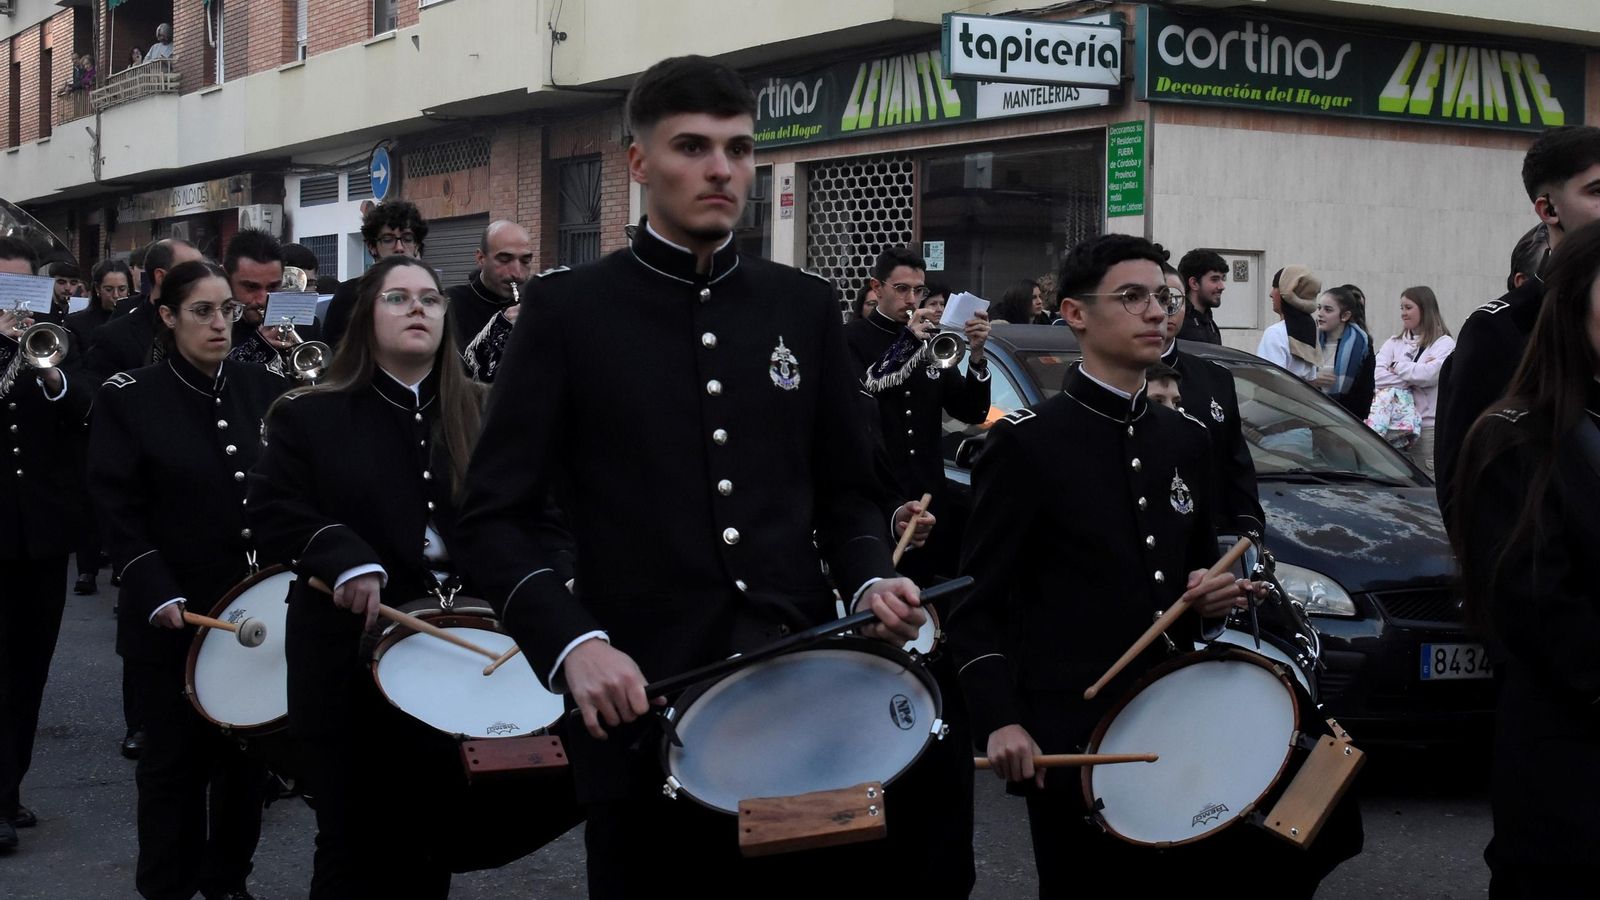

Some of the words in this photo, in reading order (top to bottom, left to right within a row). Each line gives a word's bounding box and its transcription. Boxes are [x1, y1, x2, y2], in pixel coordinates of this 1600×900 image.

[959, 22, 1119, 73] tapicería
[1157, 20, 1352, 81] cortinas
[1155, 76, 1262, 101] Decoración
[1265, 86, 1294, 102] del
[1296, 88, 1353, 110] Hogar
[1378, 40, 1565, 126] LEVANTE
[756, 76, 824, 121] rtinas
[776, 125, 792, 140] del
[791, 123, 823, 139] Hogar
[1109, 125, 1136, 135] Decoramos
[1116, 135, 1142, 146] Residencia
[1117, 147, 1134, 157] FUERA
[1109, 161, 1117, 169] de
[1116, 158, 1138, 168] Córdoba
[1114, 169, 1137, 179] Provincia
[1434, 647, 1491, 675] 8434
